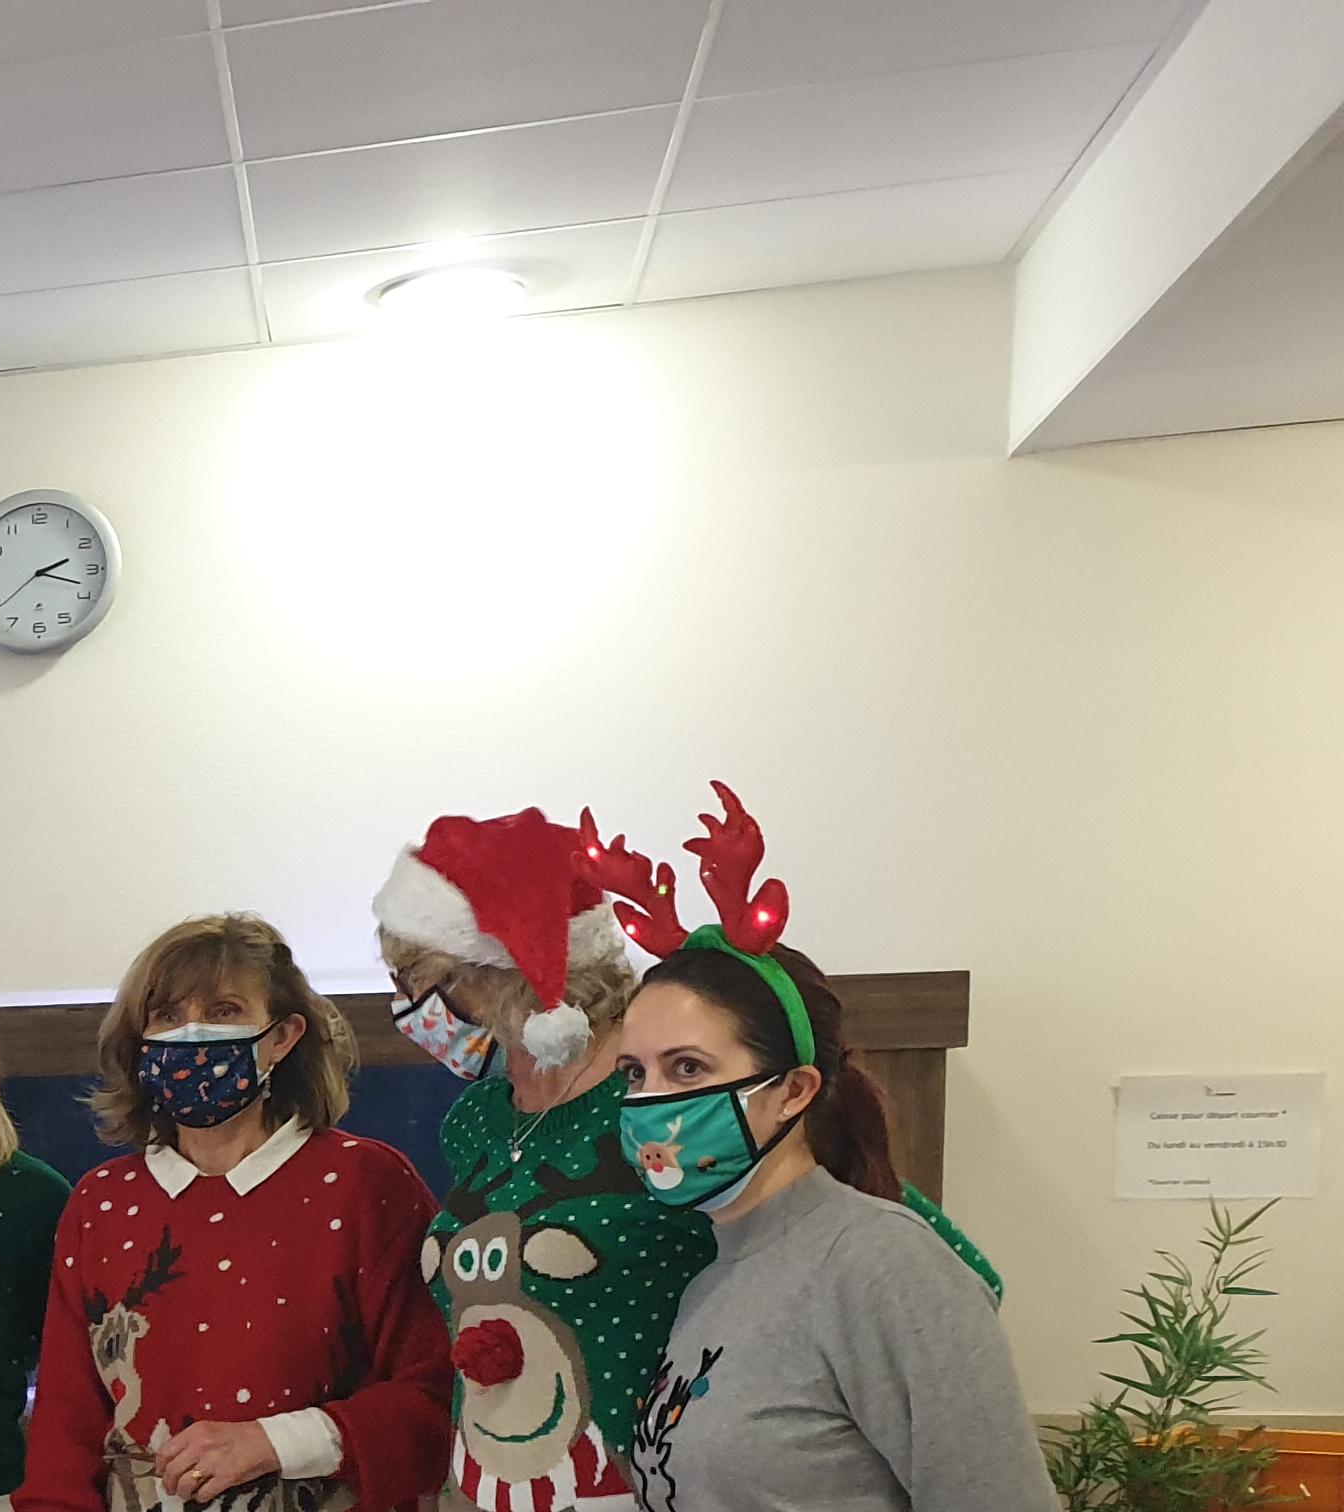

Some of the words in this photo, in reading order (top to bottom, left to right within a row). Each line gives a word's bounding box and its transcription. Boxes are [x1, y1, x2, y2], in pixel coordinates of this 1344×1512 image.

[31, 513, 49, 525] 12
[7, 523, 18, 535] 11
[78, 537, 92, 550] 2
[86, 563, 99, 576] 3
[6, 616, 19, 628] 7
[57, 612, 72, 625] 5
[32, 622, 47, 633] 6
